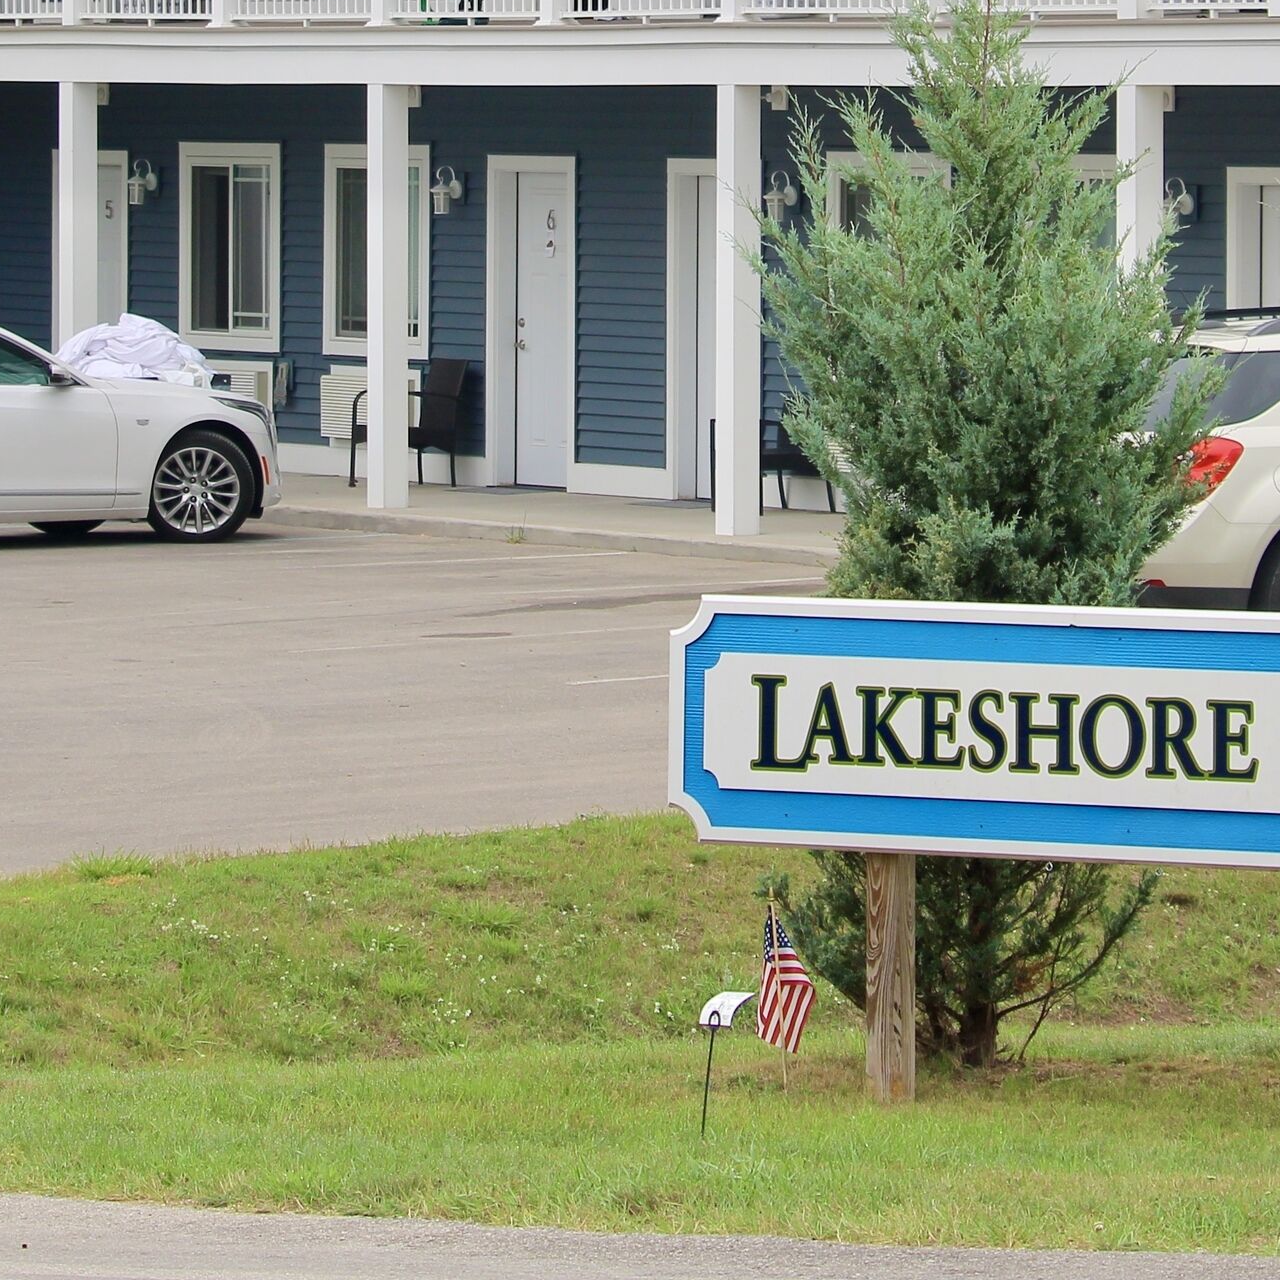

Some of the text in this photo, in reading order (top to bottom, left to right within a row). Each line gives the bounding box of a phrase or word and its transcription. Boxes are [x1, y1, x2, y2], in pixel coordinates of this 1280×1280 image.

[105, 200, 113, 220] 5
[547, 209, 555, 230] 6
[750, 673, 1259, 783] LAKESHORE
